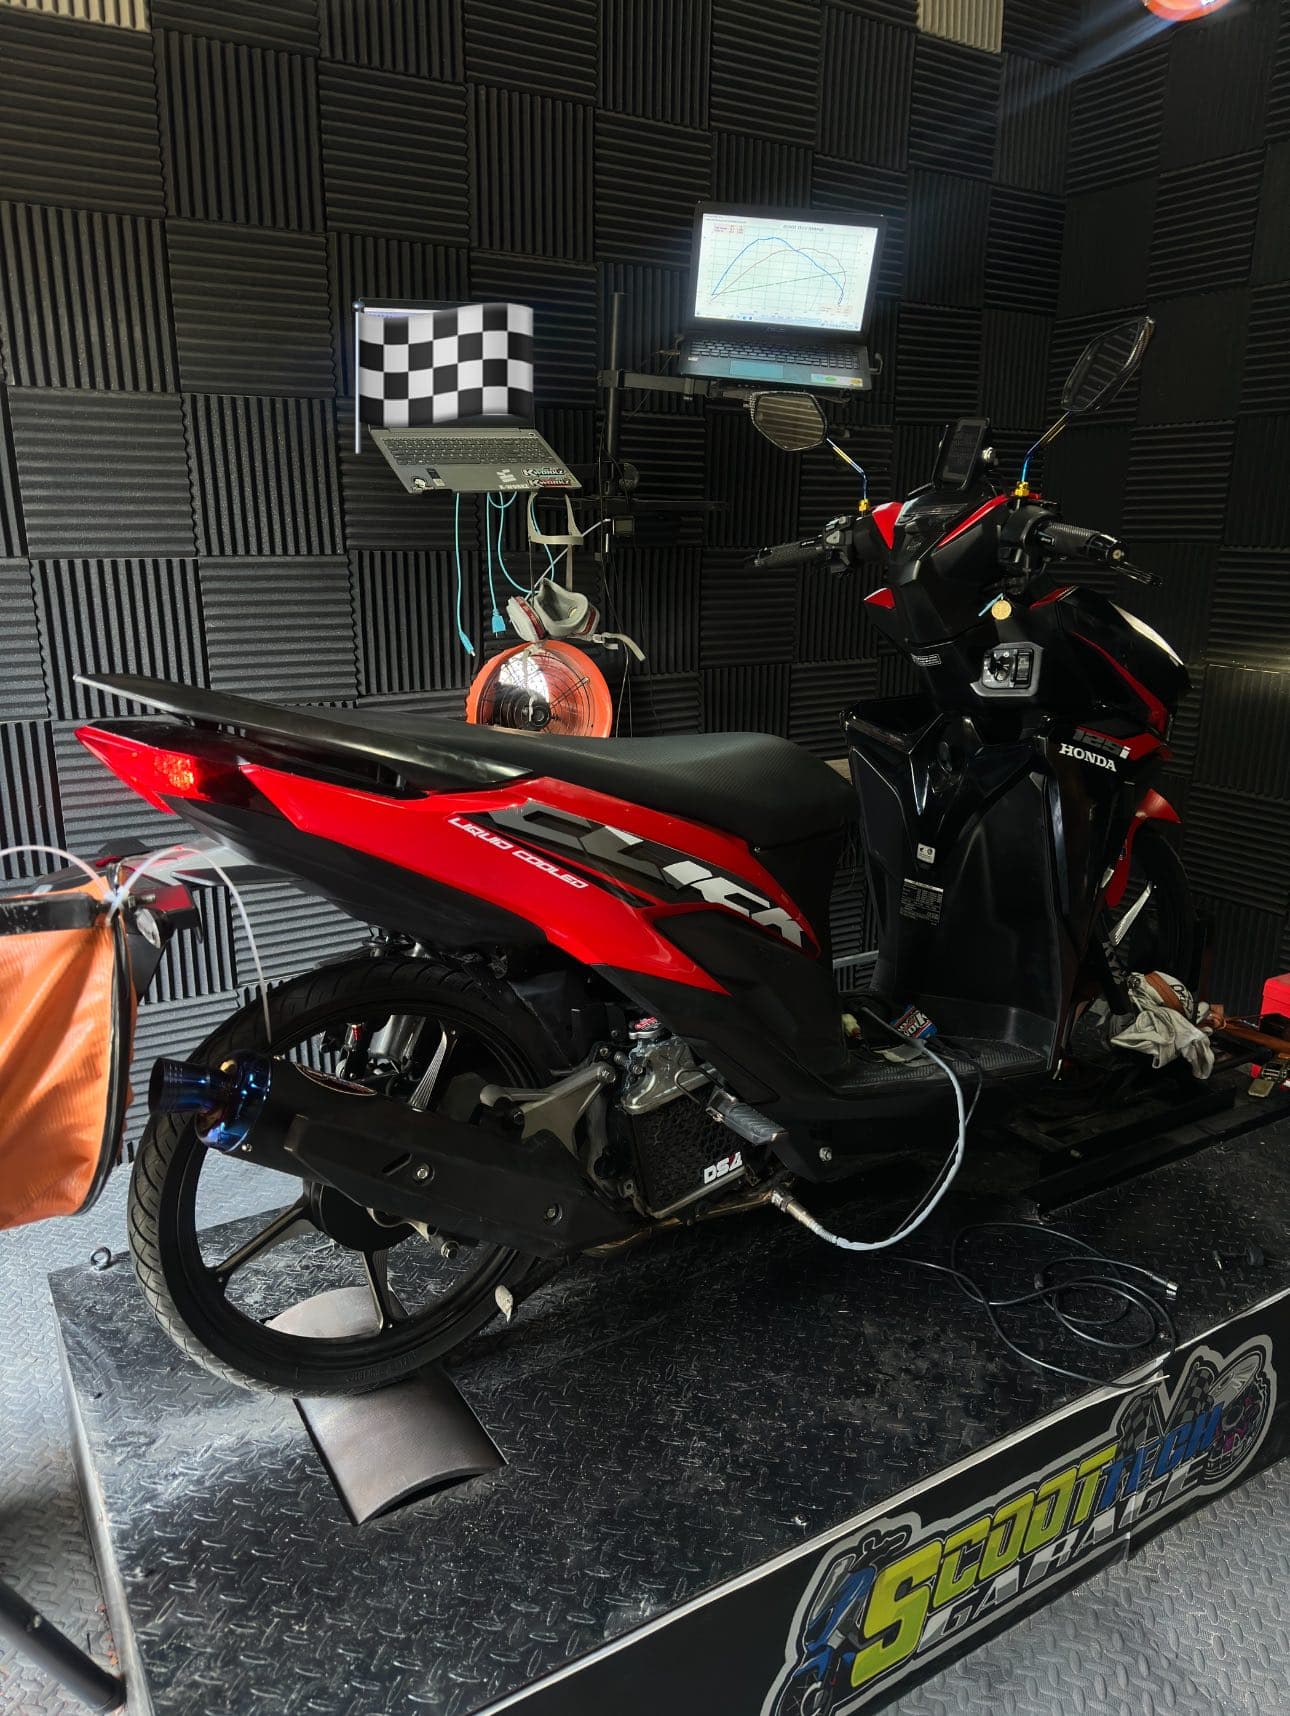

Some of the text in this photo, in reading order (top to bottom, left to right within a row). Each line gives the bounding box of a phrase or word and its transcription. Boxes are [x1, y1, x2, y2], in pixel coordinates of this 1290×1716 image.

[1059, 743, 1117, 773] HONDA
[448, 817, 589, 889] LIQUID COOLED
[917, 1452, 1209, 1653] GARAGE
